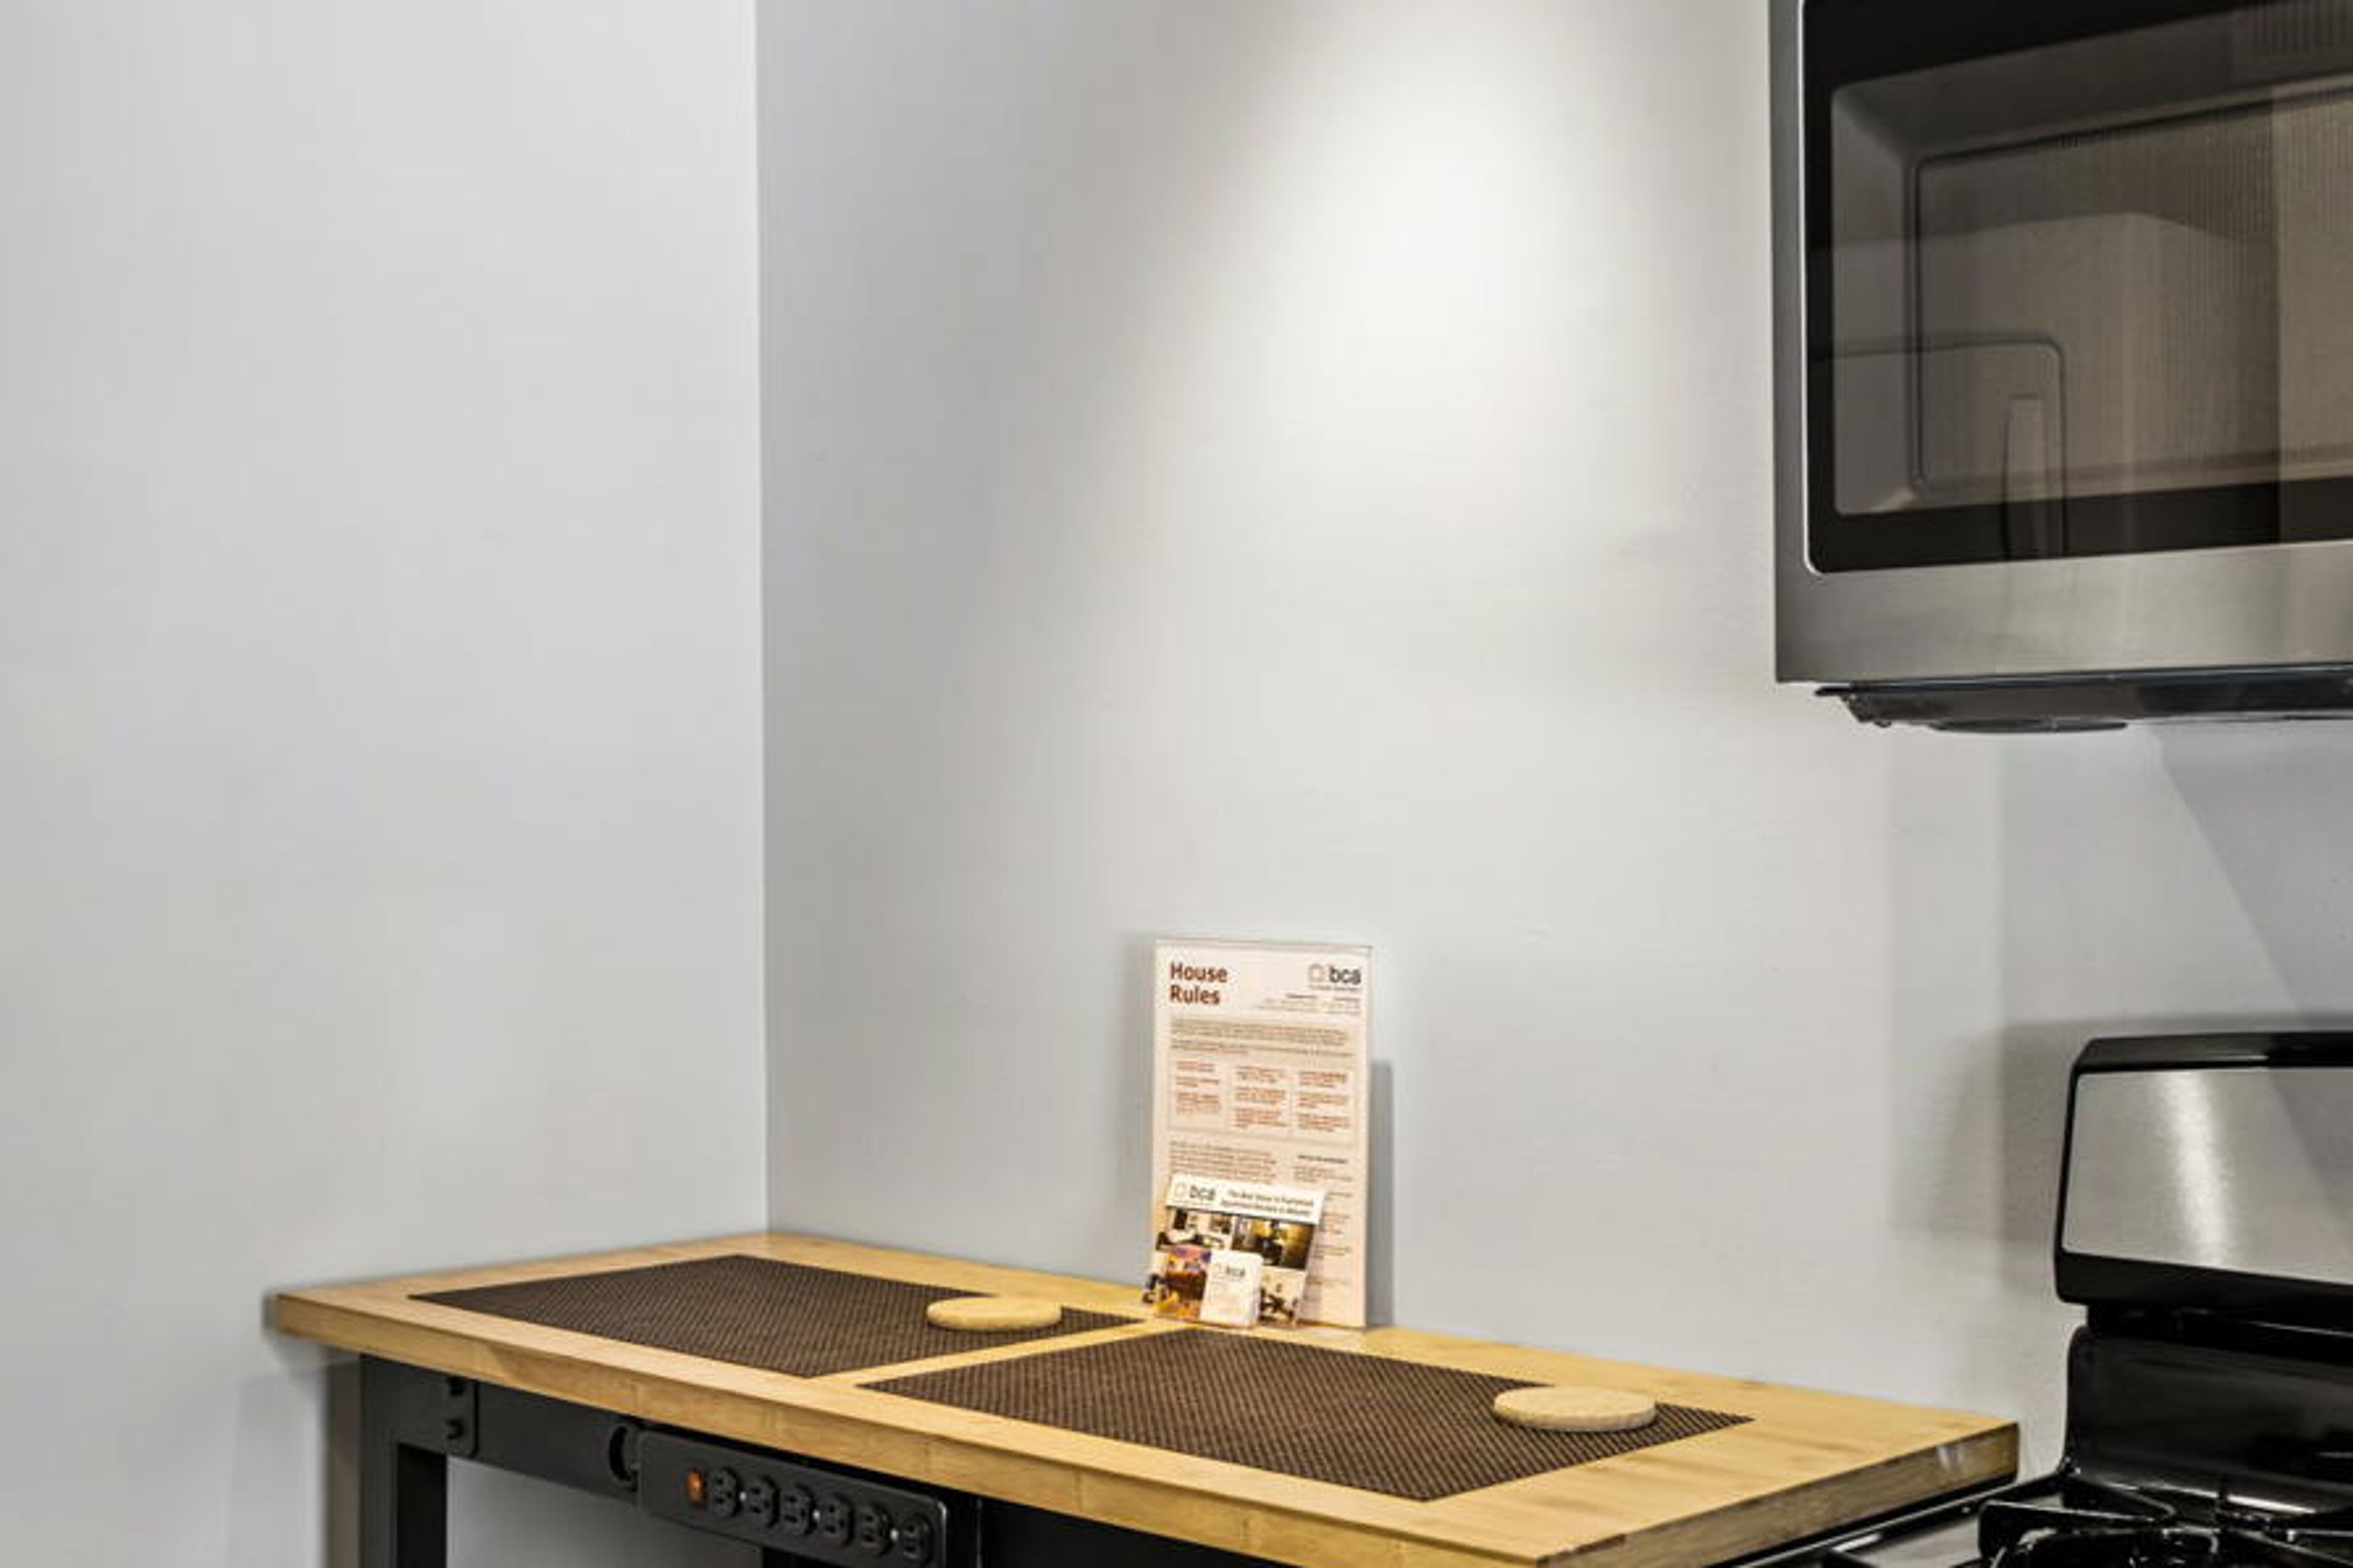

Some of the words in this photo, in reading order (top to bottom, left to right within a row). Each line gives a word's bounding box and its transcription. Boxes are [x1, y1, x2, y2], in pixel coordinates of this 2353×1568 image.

[1170, 961, 1227, 983] House
[1328, 966, 1361, 985] bca
[1170, 984, 1219, 1004] Rules
